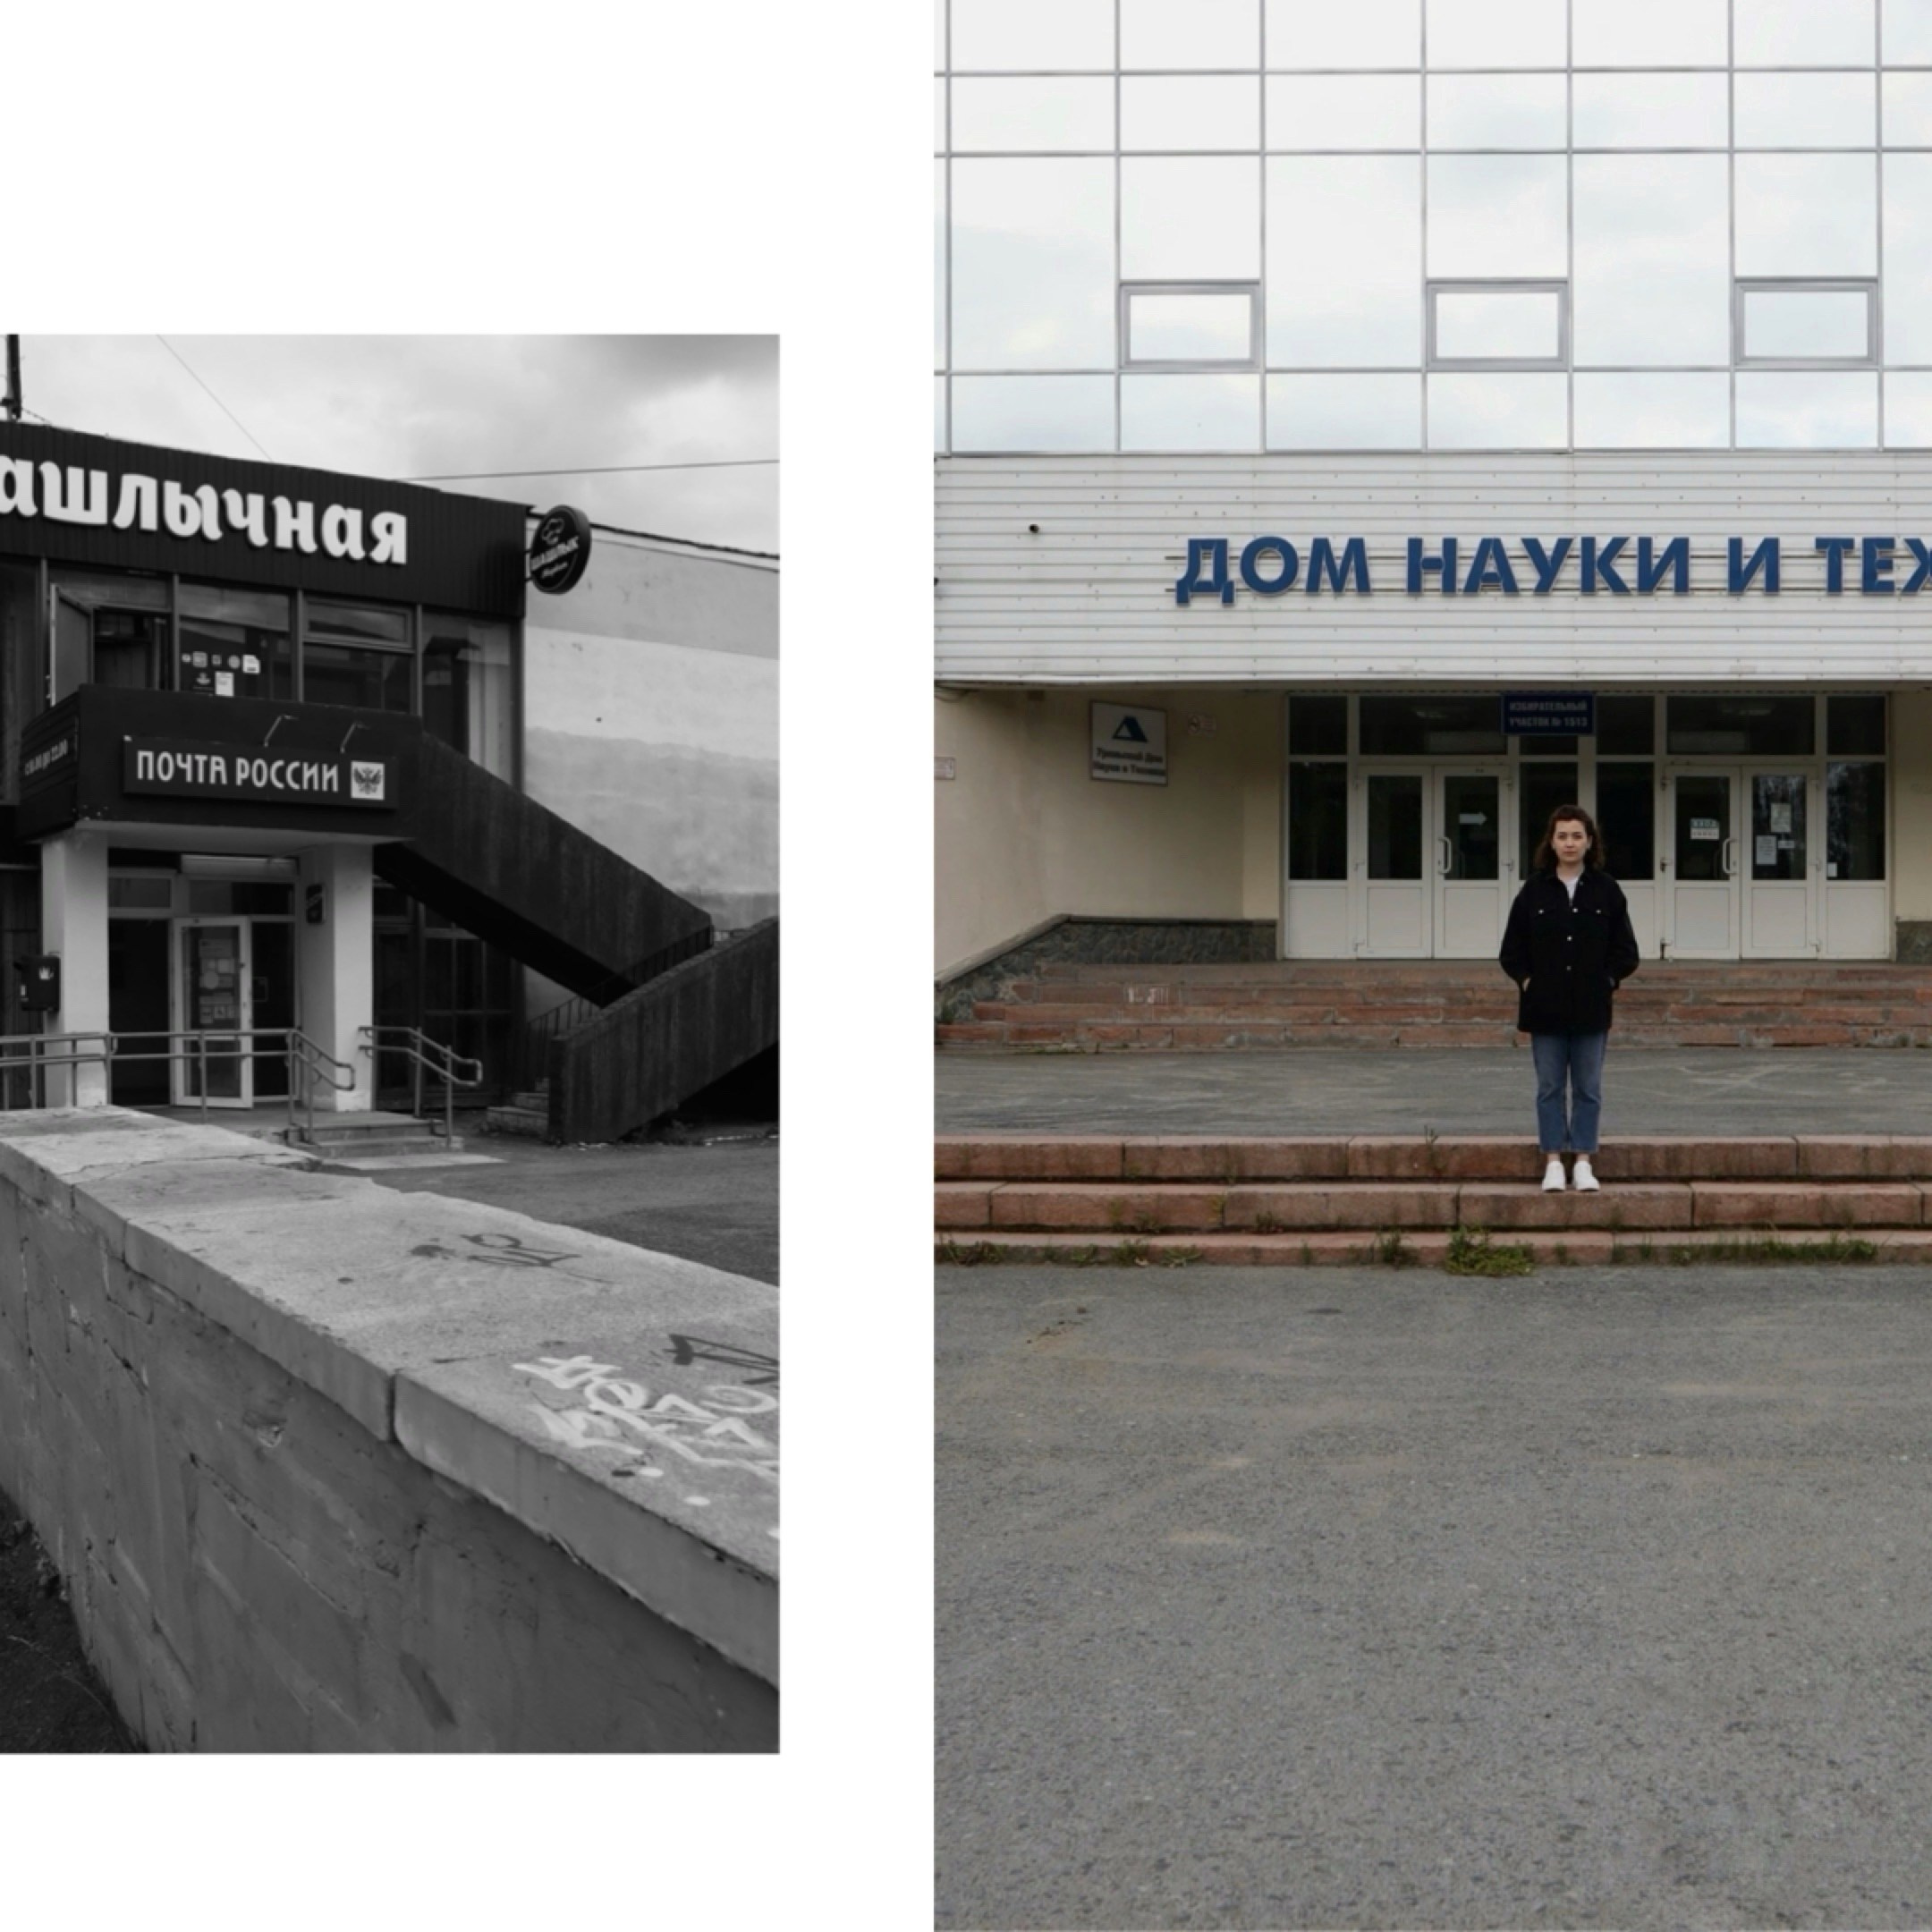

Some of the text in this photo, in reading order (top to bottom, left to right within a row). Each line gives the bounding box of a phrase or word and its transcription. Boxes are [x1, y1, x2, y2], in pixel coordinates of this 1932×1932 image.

[0, 455, 407, 564] ашлычная
[1175, 537, 1371, 605] ДОМ
[1407, 538, 1690, 593] НАУКИ
[1727, 538, 1780, 593] И
[137, 750, 339, 792] ПОЧТА РОССИИ
